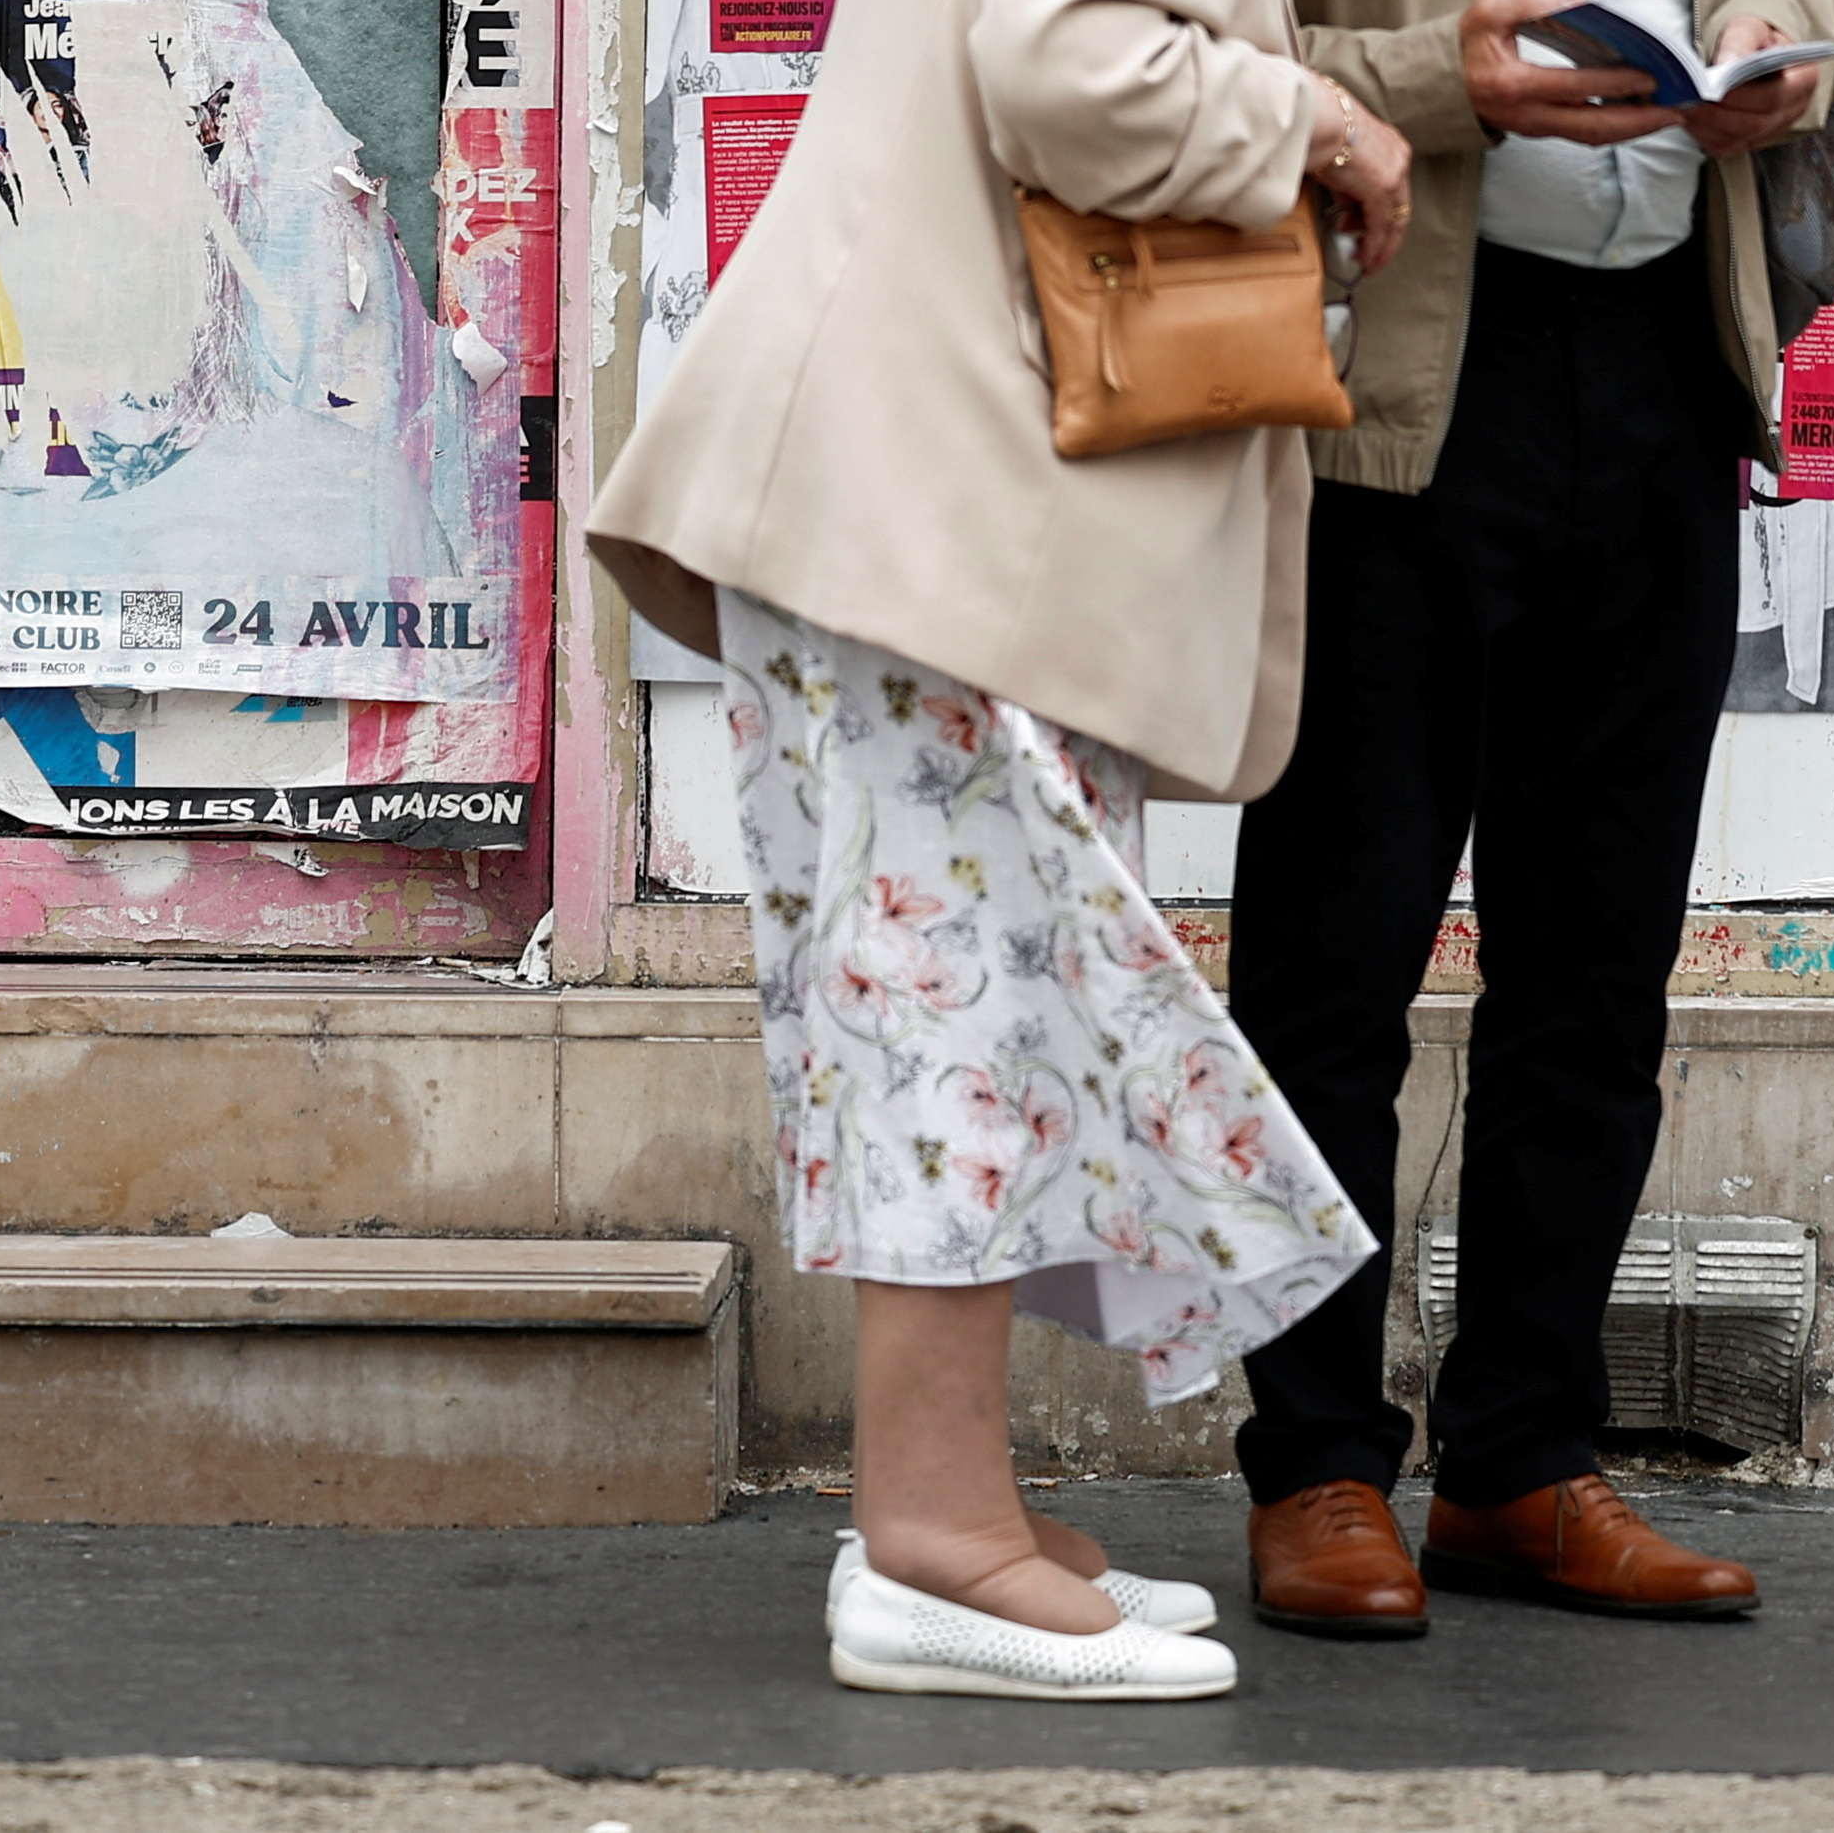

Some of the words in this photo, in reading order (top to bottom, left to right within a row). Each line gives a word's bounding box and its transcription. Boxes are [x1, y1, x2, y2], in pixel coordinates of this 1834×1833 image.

[13, 625, 101, 651] CLUB
[204, 600, 273, 646] 24
[299, 600, 490, 650] AVRIL
[180, 798, 255, 821] LES
[263, 789, 297, 826] À
[308, 801, 361, 832] LA
[370, 793, 523, 825] MAISON
